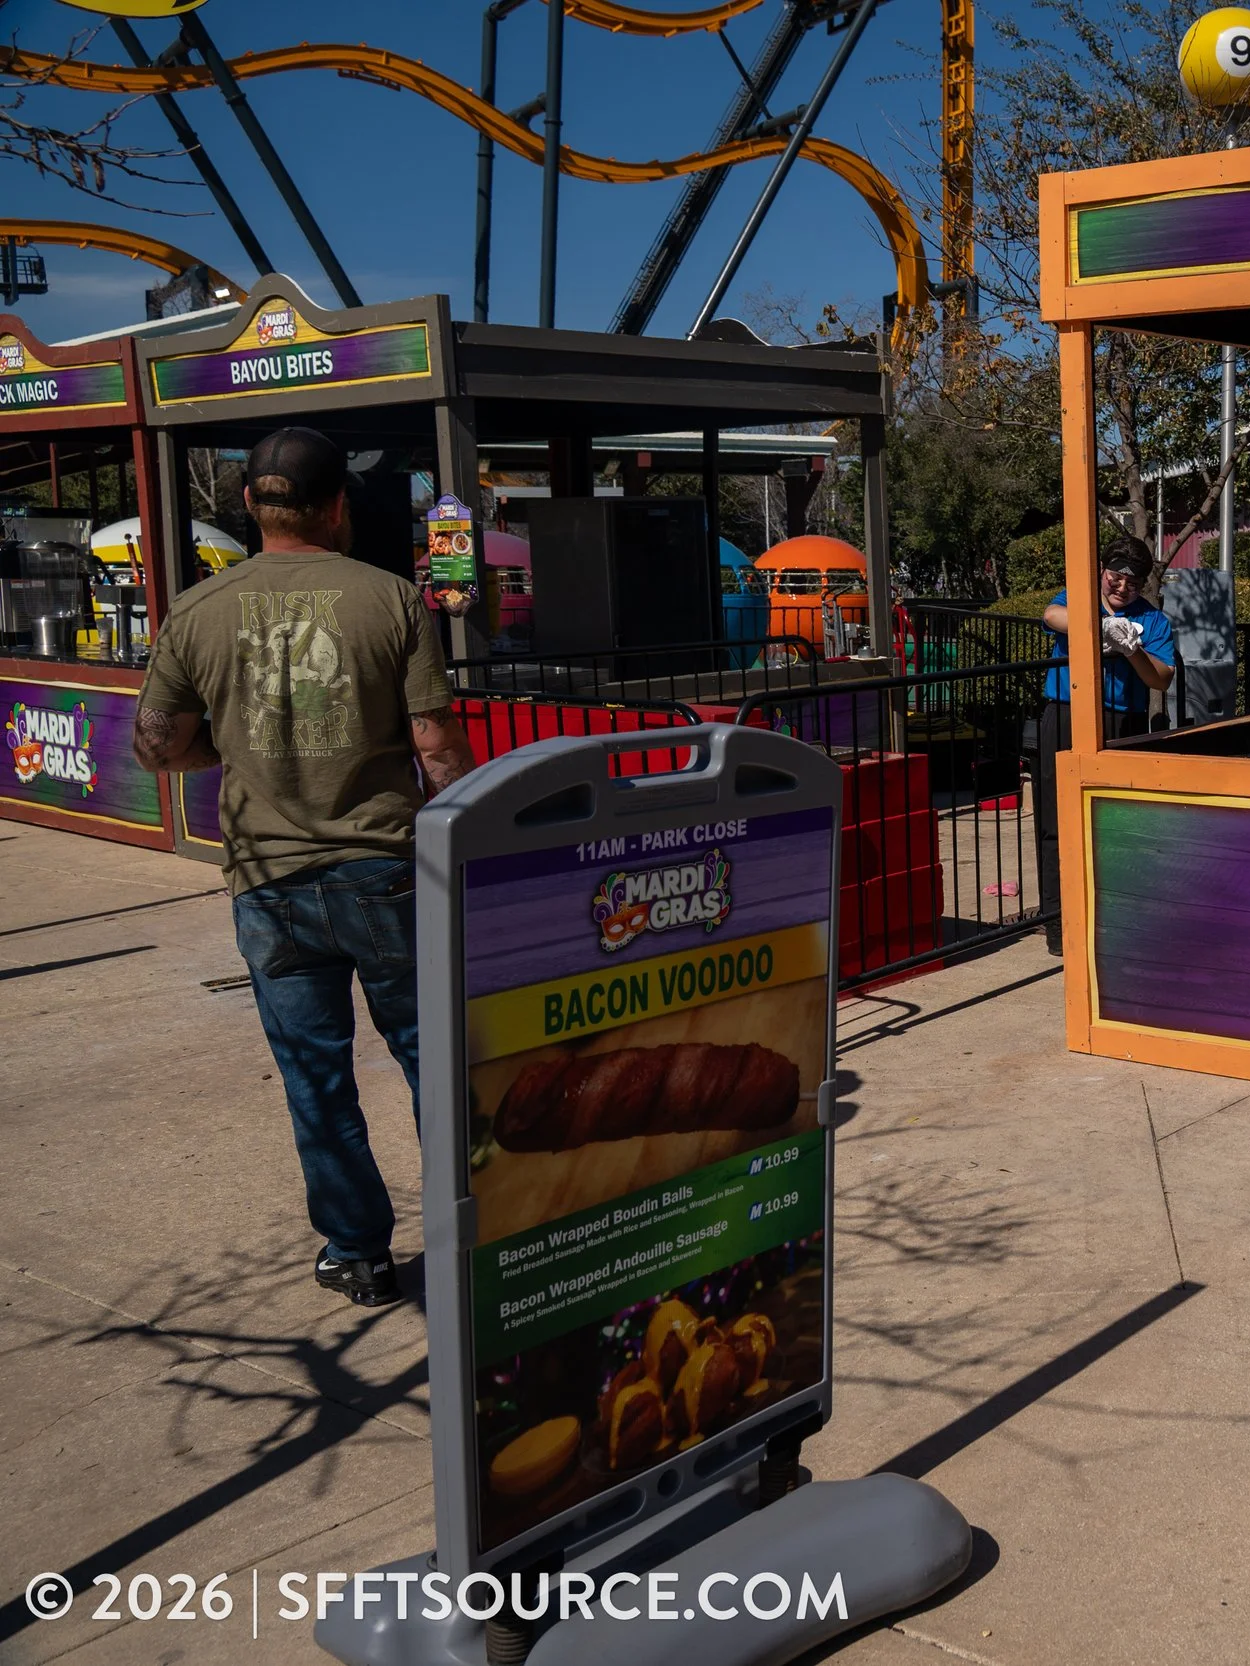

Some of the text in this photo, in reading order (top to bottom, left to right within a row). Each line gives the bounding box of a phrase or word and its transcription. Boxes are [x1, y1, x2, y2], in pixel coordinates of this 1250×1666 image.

[265, 312, 289, 326] MARDI
[272, 324, 294, 338] GRAS
[231, 350, 333, 385] BAYOU BITES
[16, 379, 58, 403] MAGIC
[238, 590, 343, 637] RISK
[25, 707, 75, 748] MARDI
[241, 704, 352, 750] TAKER
[43, 744, 92, 783] GRAS
[262, 751, 284, 759] PLAY
[311, 749, 333, 757] LUCK
[576, 836, 625, 862] 11AM
[642, 828, 688, 852] PARK
[693, 819, 747, 843] CLOSE
[625, 864, 705, 903] MARDI
[650, 890, 722, 929] GRAS
[544, 943, 774, 1036] BACON VOODOO
[765, 1147, 799, 1170] 10.99
[765, 1191, 799, 1215] 10.99
[499, 1185, 693, 1267] Bacon Wrapped Boudin Balls
[502, 1265, 522, 1280] Fried
[523, 1254, 554, 1272] Breaded
[586, 1233, 606, 1248] Made
[607, 1229, 622, 1240] with
[623, 1223, 639, 1234] Rice
[640, 1216, 652, 1228] and
[689, 1193, 716, 1210] Wrapped
[724, 1184, 744, 1196] Bacon
[499, 1219, 728, 1318] Bacon Wrapped Andouille Sausage
[503, 1321, 510, 1331] A
[536, 1299, 565, 1318] Smoked
[597, 1275, 628, 1293] Wrapped
[628, 1273, 636, 1281] in
[636, 1264, 658, 1278] Bacon
[658, 1258, 671, 1269] and
